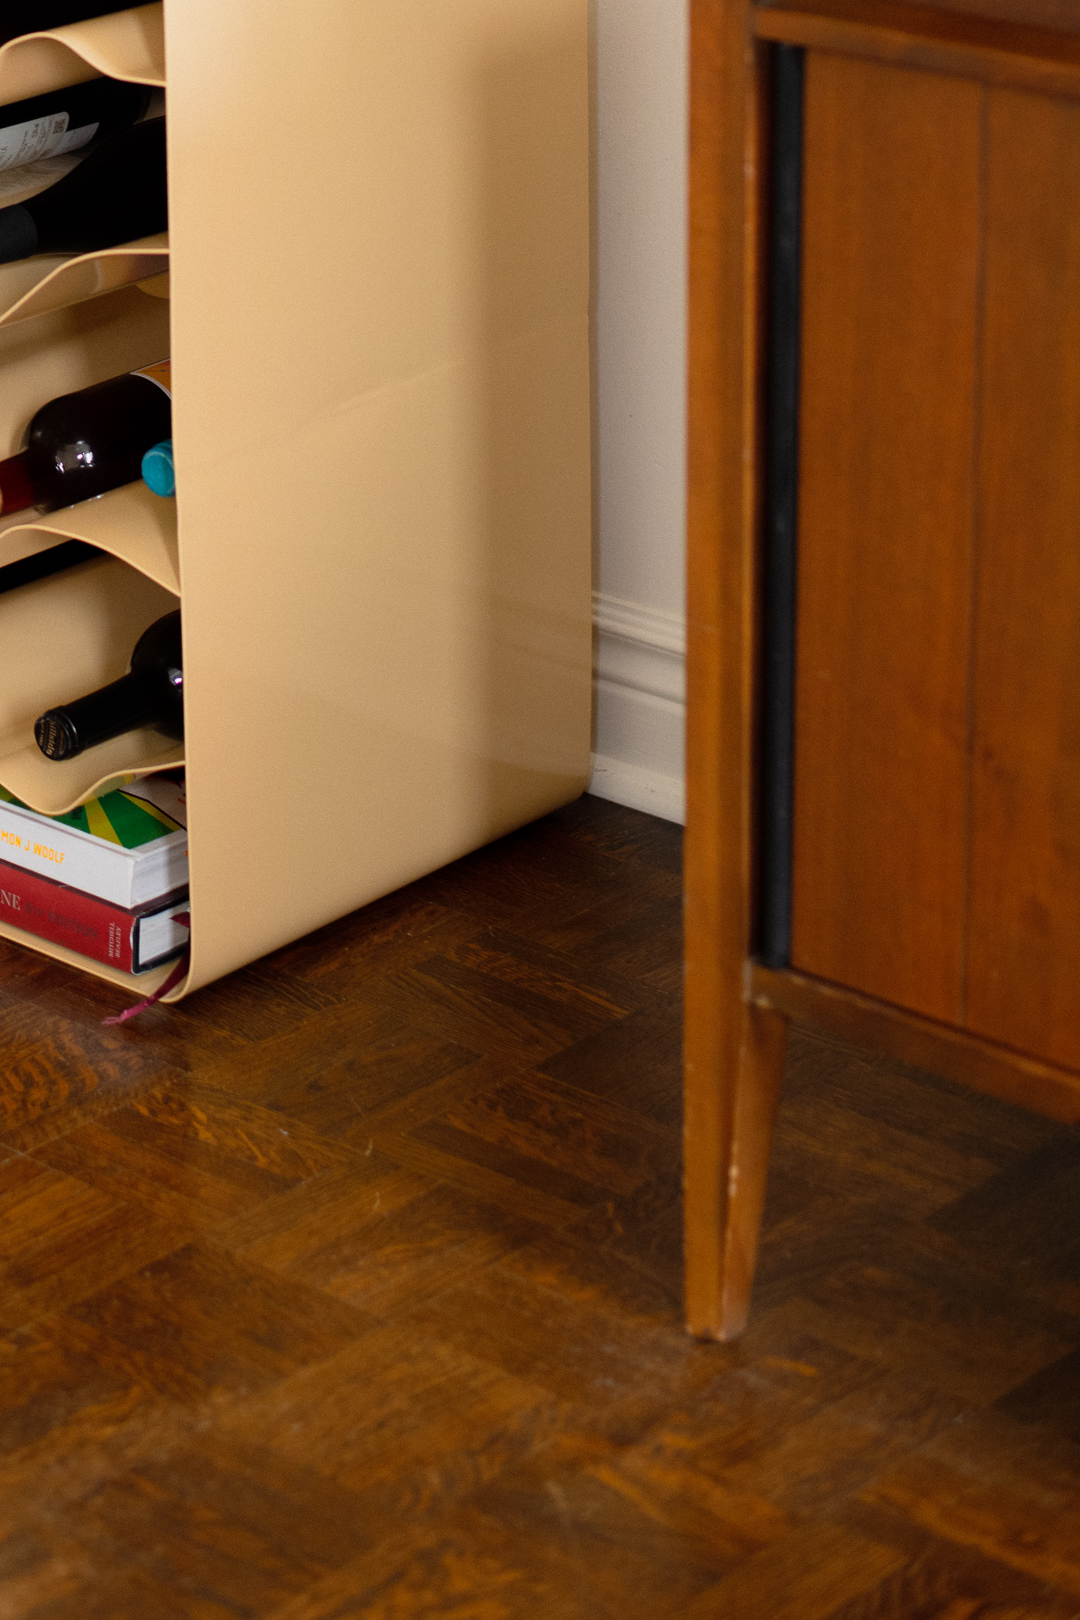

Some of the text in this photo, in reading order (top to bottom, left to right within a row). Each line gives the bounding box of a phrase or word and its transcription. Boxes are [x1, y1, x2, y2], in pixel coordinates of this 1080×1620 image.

[24, 840, 30, 851] J
[33, 842, 65, 864] WOOLF
[48, 911, 99, 940] EDITION
